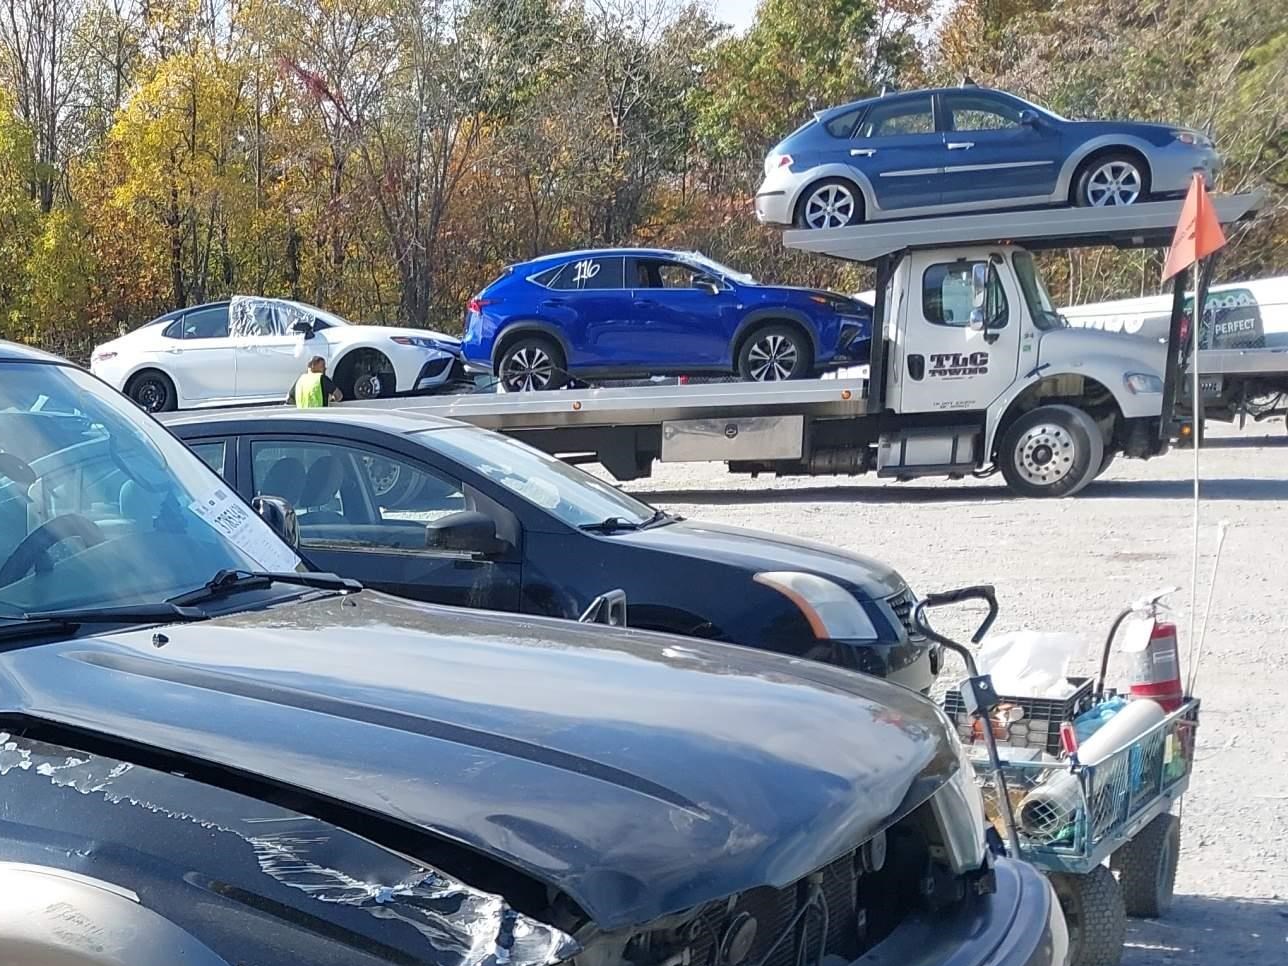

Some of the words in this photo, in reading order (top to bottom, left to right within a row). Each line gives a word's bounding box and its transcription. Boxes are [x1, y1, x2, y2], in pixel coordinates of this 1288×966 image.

[573, 259, 601, 287] 116
[1215, 318, 1256, 335] PERFECT
[930, 352, 989, 369] TLC
[928, 366, 989, 377] TOWING
